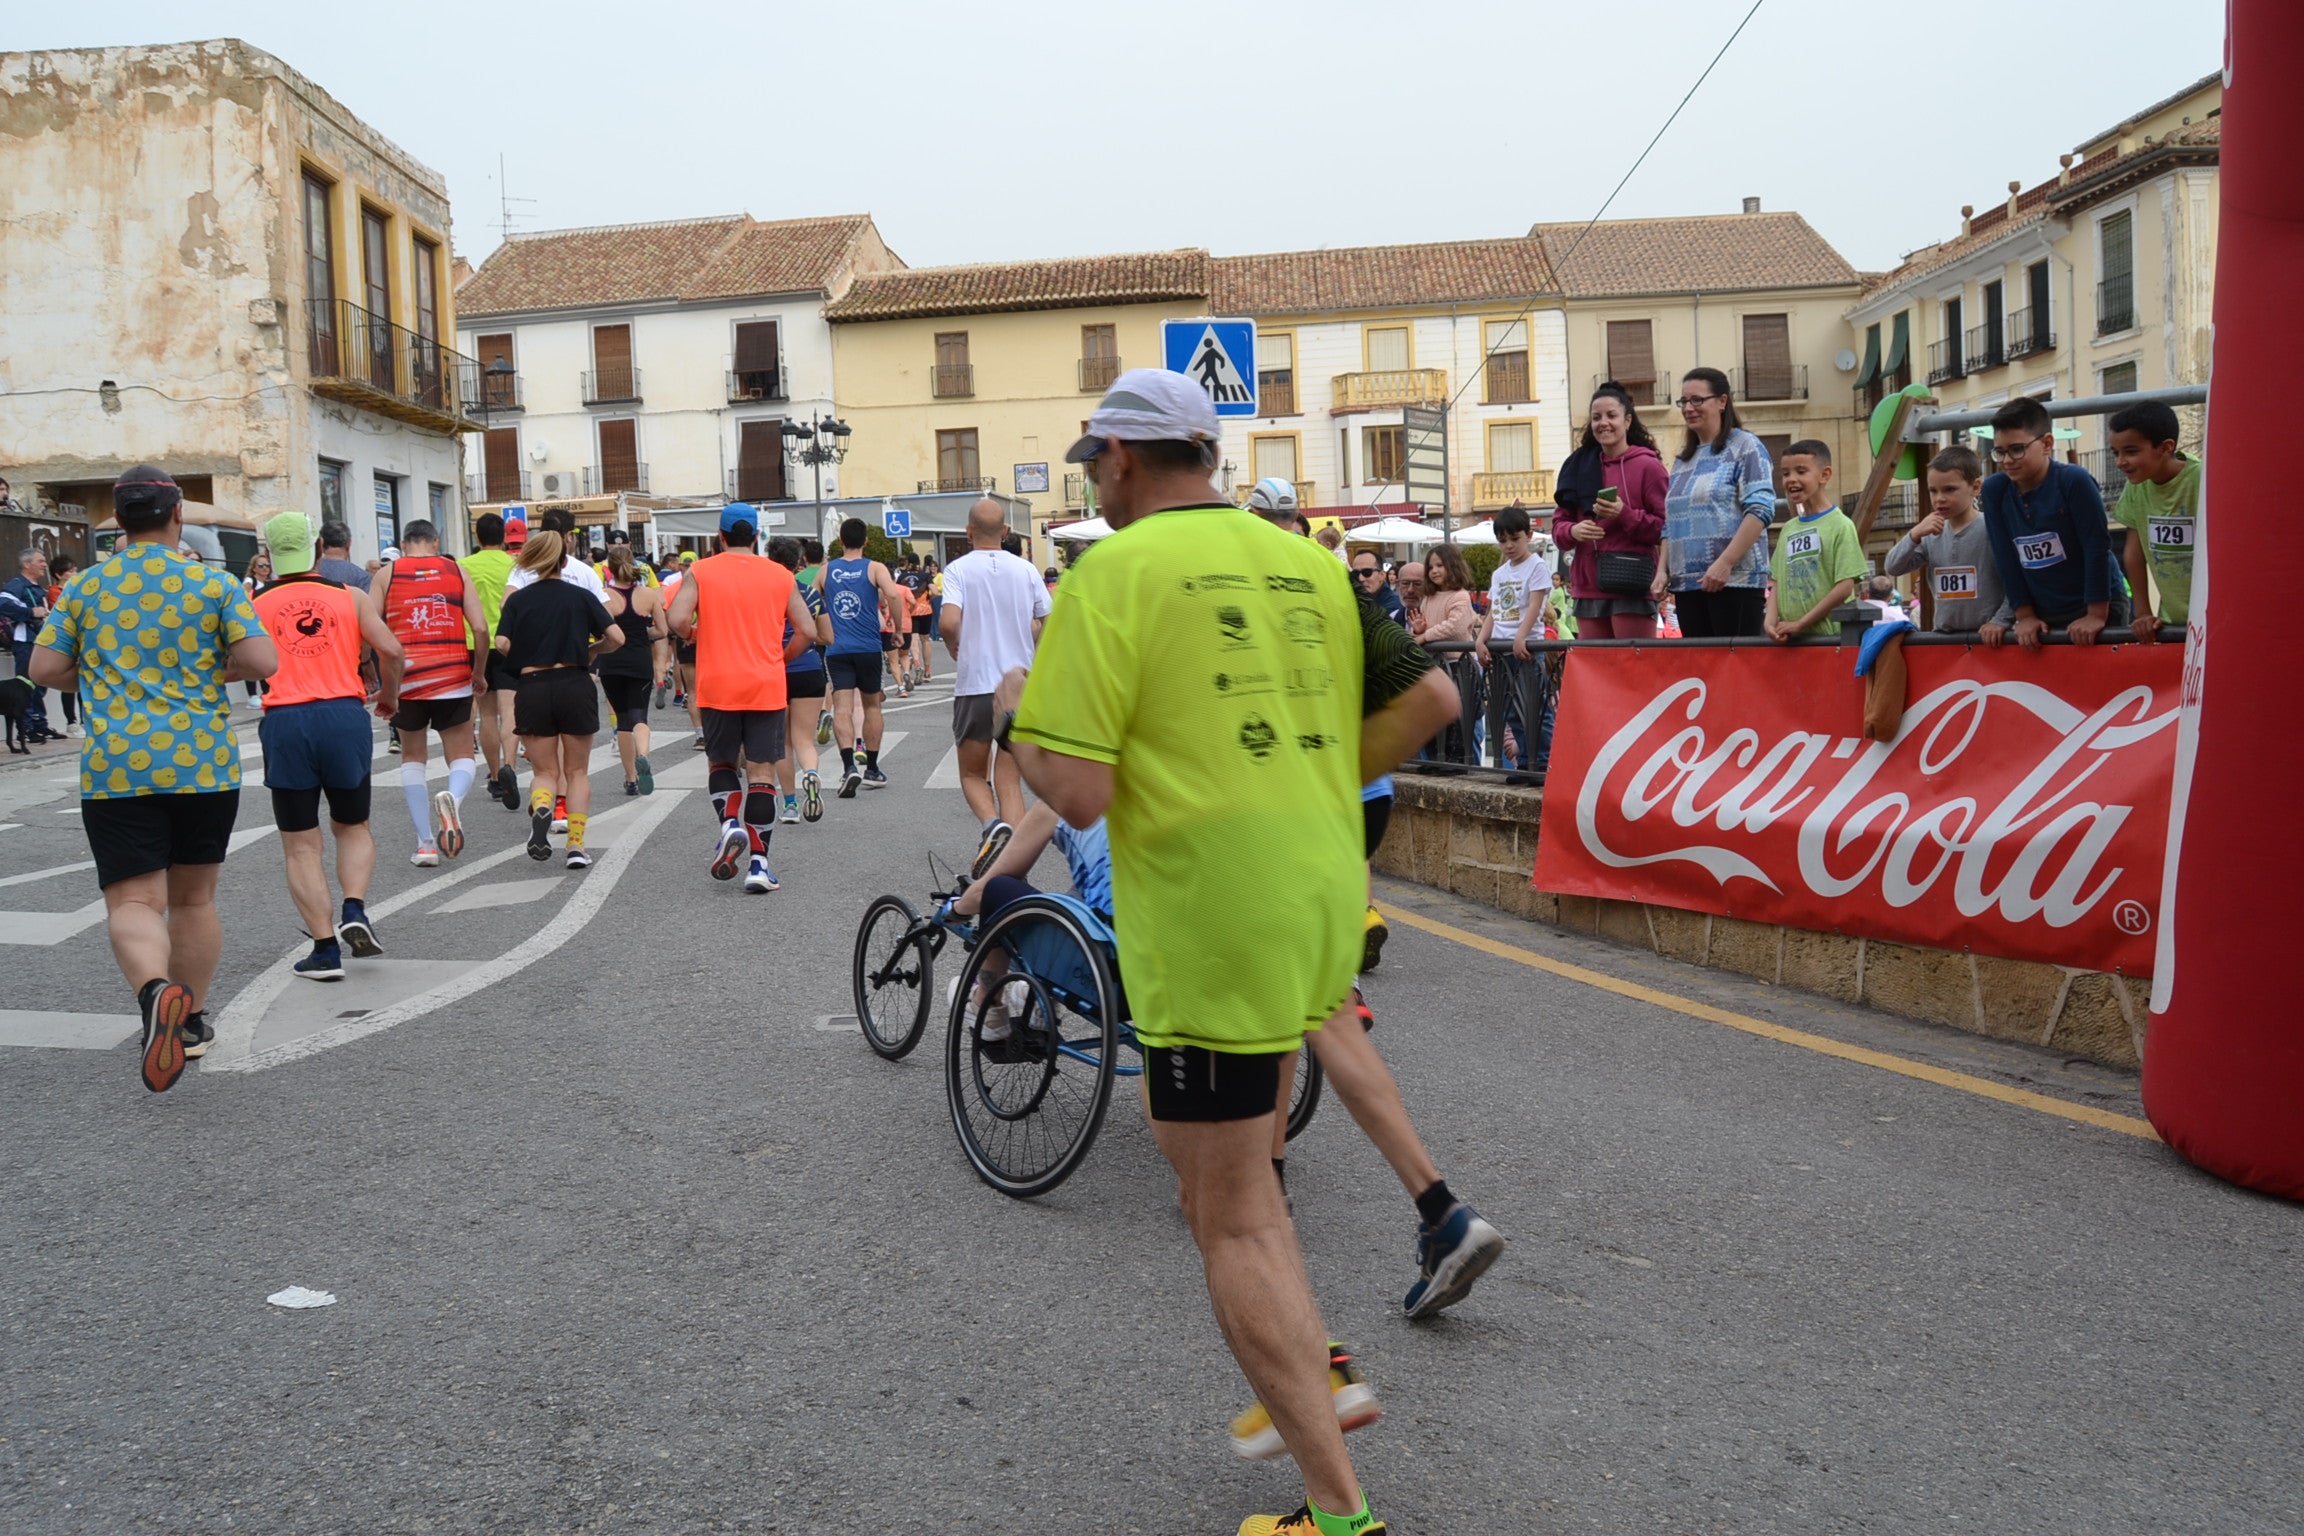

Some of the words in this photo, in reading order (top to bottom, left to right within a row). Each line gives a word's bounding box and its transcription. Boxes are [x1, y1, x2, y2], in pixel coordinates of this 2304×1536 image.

[2155, 526, 2184, 544] 129
[1791, 536, 1811, 553] 128
[2023, 541, 2055, 560] 052
[1941, 575, 1967, 591] 081
[1575, 676, 2182, 929] Coca-Cola
